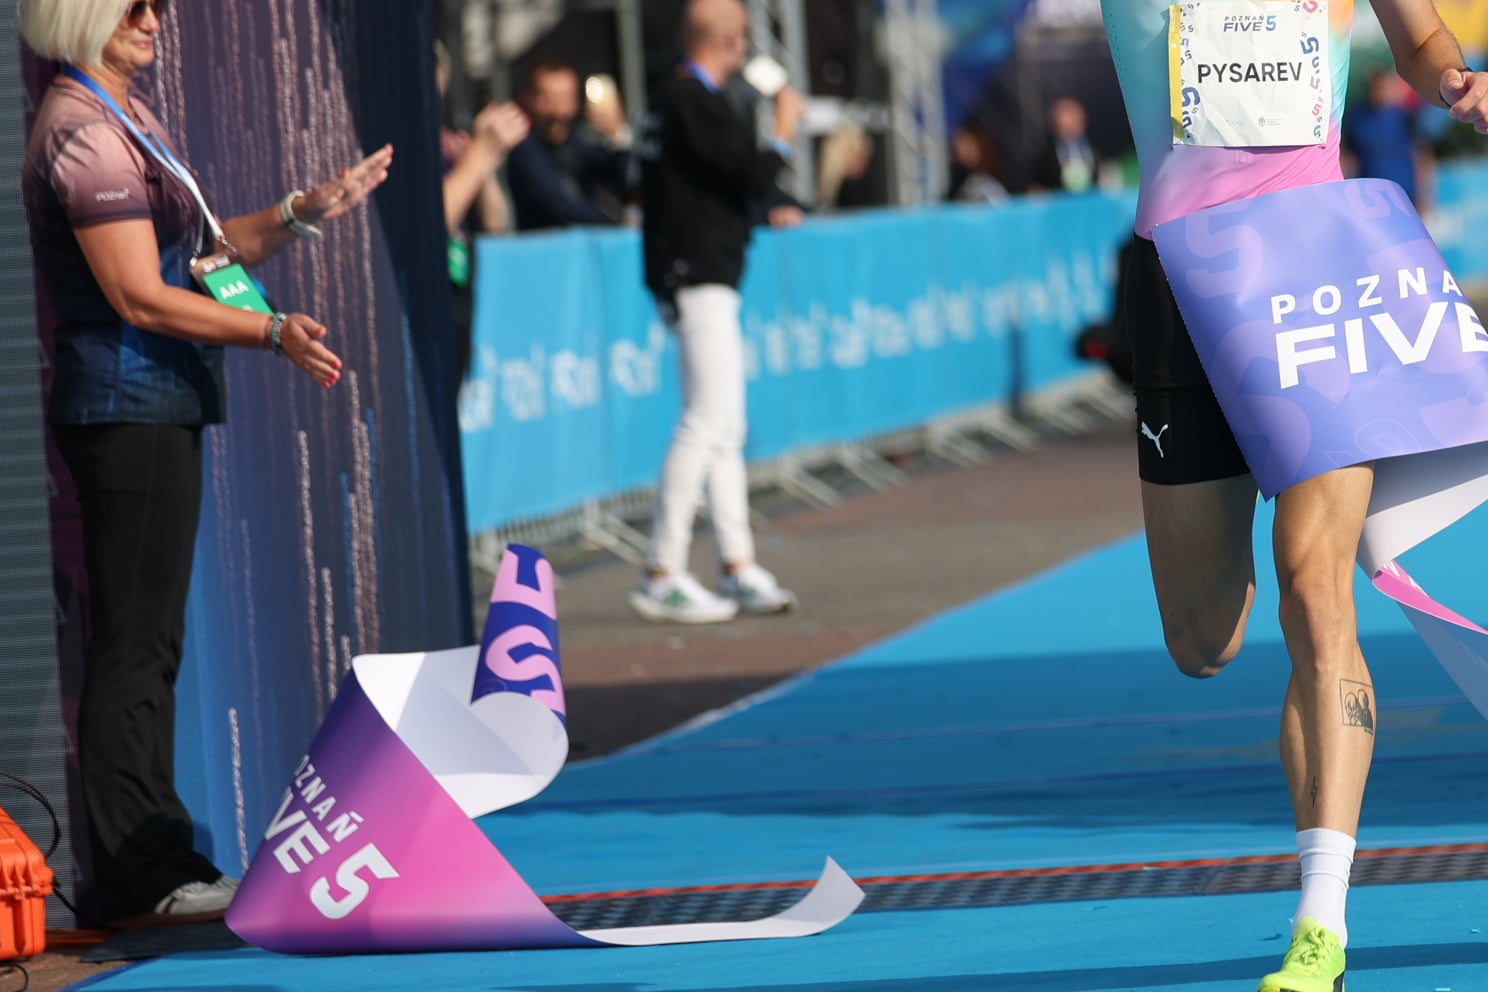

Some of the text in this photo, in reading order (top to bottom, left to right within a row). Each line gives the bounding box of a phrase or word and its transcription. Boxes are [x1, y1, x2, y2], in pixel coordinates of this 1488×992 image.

[1223, 15, 1277, 32] FIVE 5
[1197, 62, 1302, 83] PYSAREV
[310, 843, 400, 919] 5
